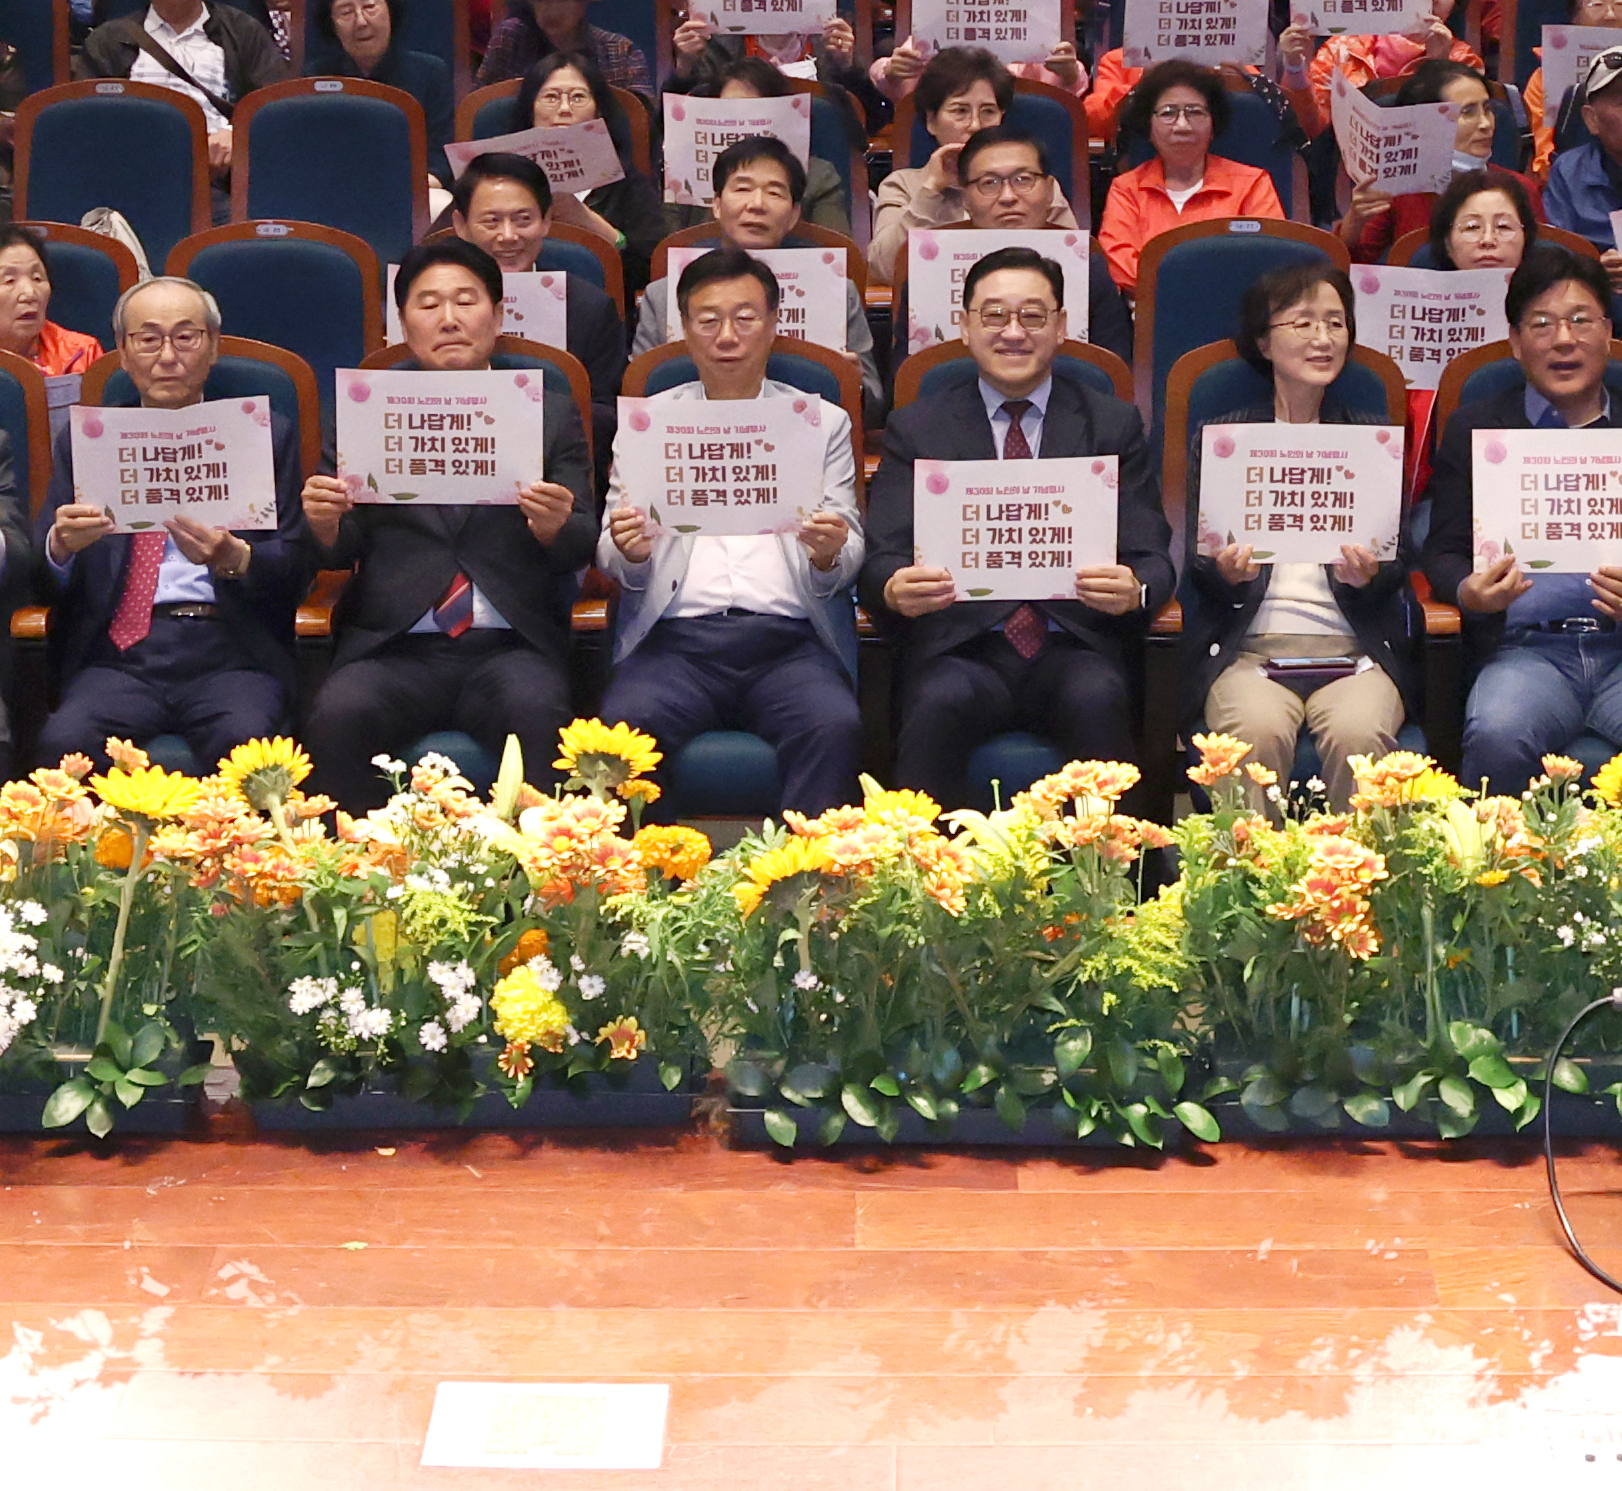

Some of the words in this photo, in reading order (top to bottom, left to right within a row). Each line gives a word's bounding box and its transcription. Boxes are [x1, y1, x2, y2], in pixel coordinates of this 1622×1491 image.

[444, 397, 452, 405] 날
[384, 413, 402, 429] 더
[408, 414, 471, 430] 나답게!
[723, 426, 731, 434] 날
[119, 447, 136, 463] 더
[142, 444, 203, 463] 나답게!
[385, 436, 402, 452] 더
[409, 436, 445, 453] 가치
[452, 437, 495, 454] 있게!
[664, 443, 683, 460] 더
[688, 442, 751, 460] 나답게!
[1306, 450, 1313, 458] 날
[120, 468, 138, 484] 더
[144, 466, 180, 483] 가치
[184, 463, 227, 481] 있게!
[385, 458, 403, 475] 더
[410, 459, 446, 476] 품격
[452, 459, 496, 476] 있게!
[666, 467, 684, 483] 더
[690, 466, 727, 483] 가치
[732, 465, 776, 482] 있게!
[1246, 467, 1264, 484] 더
[1269, 467, 1332, 485] 나답게!
[1023, 486, 1030, 494] 날
[1521, 474, 1538, 491] 더
[1544, 474, 1606, 491] 나답게!
[122, 489, 139, 505] 더
[145, 487, 181, 505] 품격
[186, 485, 229, 502] 있게!
[667, 489, 685, 506] 더
[691, 489, 728, 506] 품격
[733, 488, 778, 505] 있게!
[1246, 491, 1263, 507] 더
[1269, 490, 1305, 507] 가치
[1311, 491, 1354, 508] 있게!
[962, 504, 980, 521] 더
[986, 503, 1049, 521] 나답게!
[1521, 498, 1539, 515] 더
[1545, 498, 1581, 515] 가치
[1245, 514, 1262, 531] 더
[1268, 514, 1304, 531] 품격
[1310, 514, 1353, 532] 있게!
[1522, 523, 1539, 540] 더
[1546, 522, 1581, 540] 품격
[962, 528, 980, 545] 더
[986, 527, 1023, 545] 가치
[1029, 527, 1072, 544] 있게!
[962, 552, 979, 569] 더
[986, 551, 1022, 569] 품격
[1028, 550, 1072, 568] 있게!
